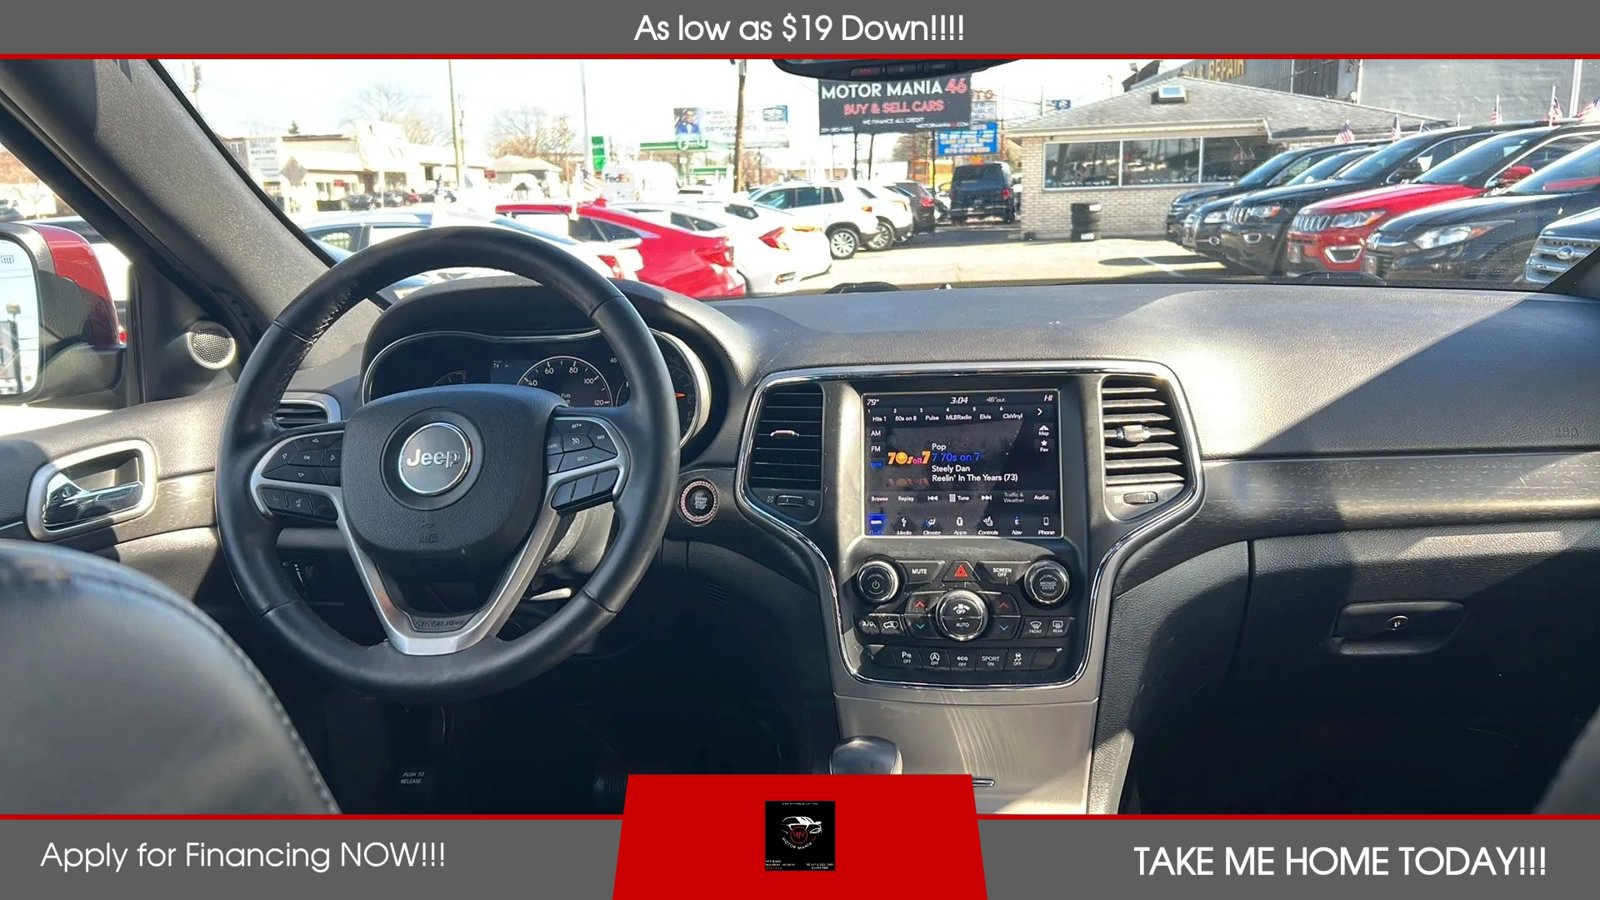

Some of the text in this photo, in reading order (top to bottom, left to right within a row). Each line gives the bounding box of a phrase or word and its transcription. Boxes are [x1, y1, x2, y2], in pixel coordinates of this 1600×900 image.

[821, 78, 968, 99] MOTOR MANIA 46
[843, 99, 944, 116] BUY & SELL CARS
[605, 173, 630, 183] FedEx
[544, 367, 555, 375] 60
[568, 366, 579, 374] 80
[949, 396, 969, 405] 3:04
[931, 443, 947, 451] Pop
[406, 448, 461, 468] Jeep
[932, 452, 981, 462] 7 70s on 7
[931, 464, 970, 474] Steely Dan
[931, 474, 957, 482] Reelin'
[958, 474, 966, 482] In
[1004, 473, 1019, 482] (73)
